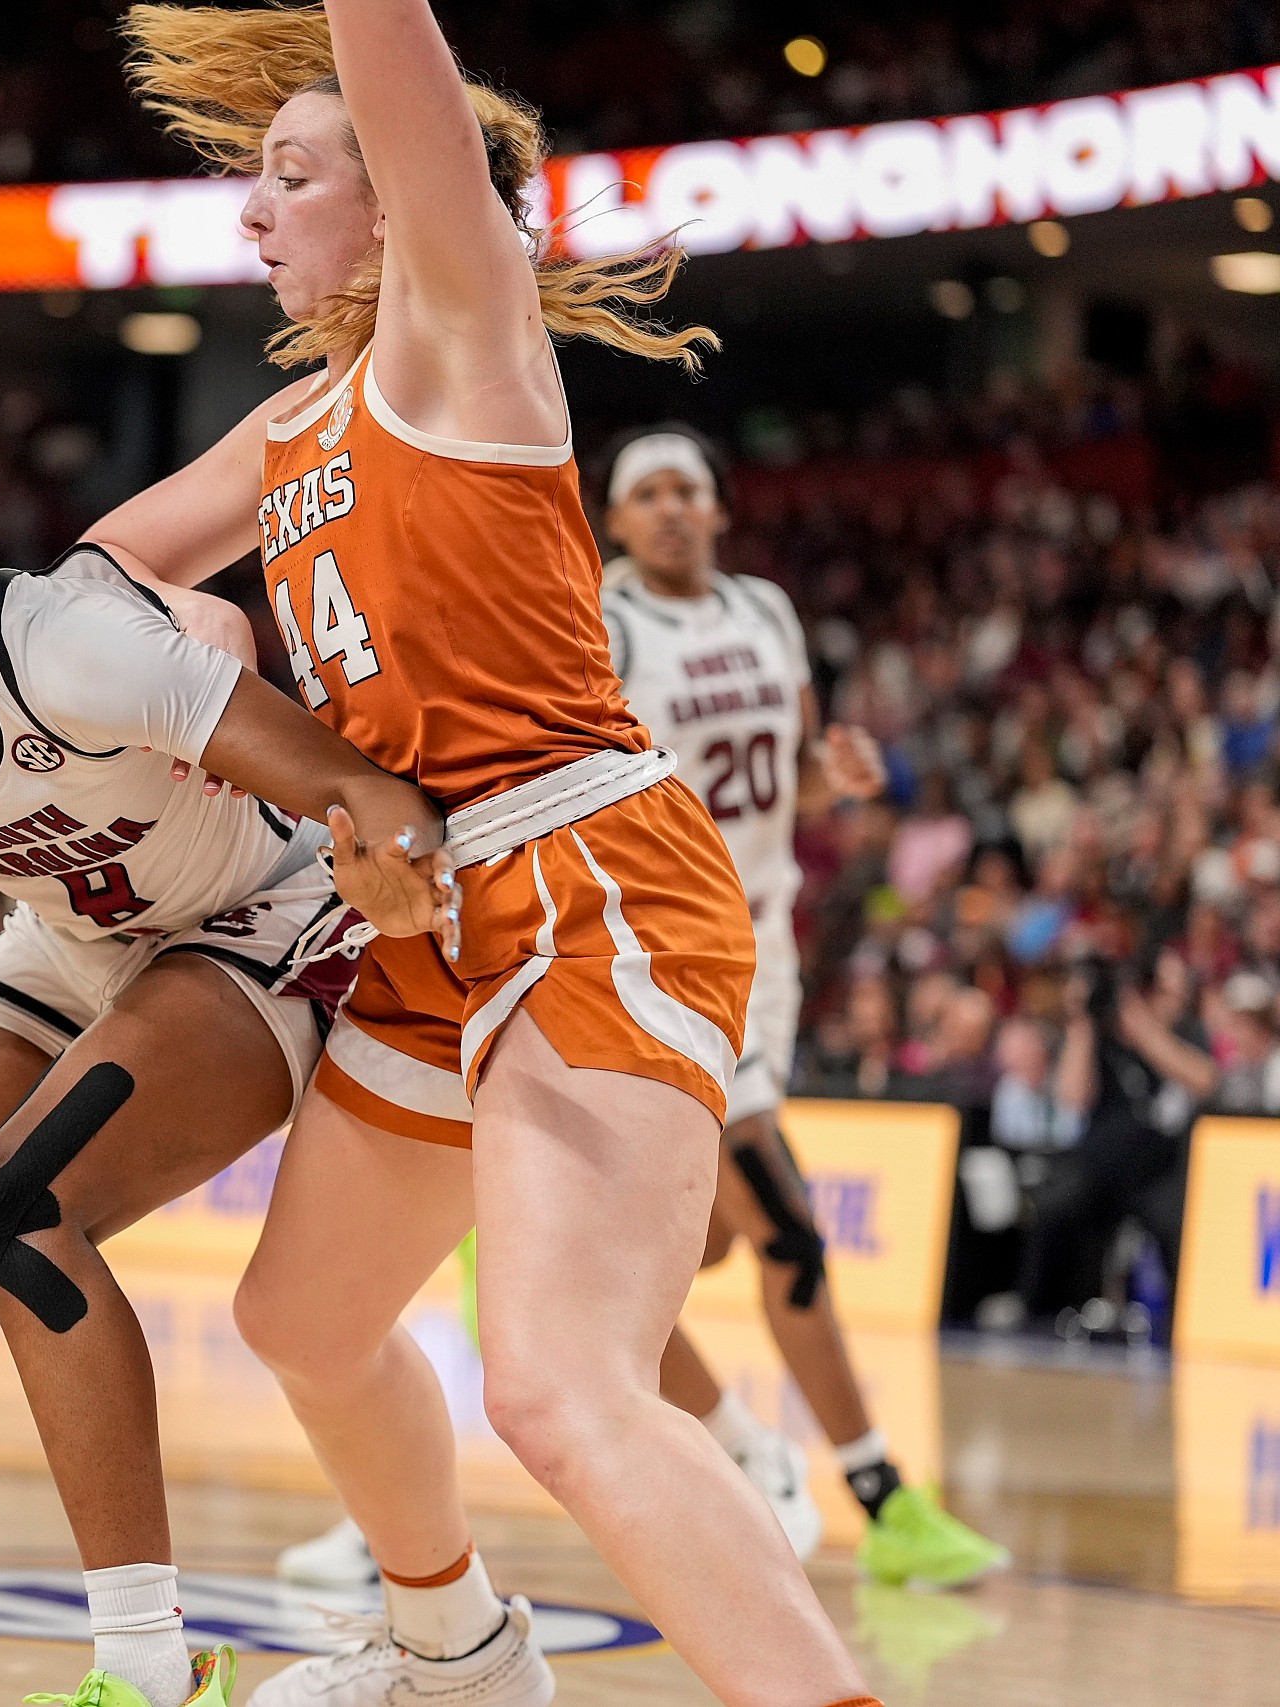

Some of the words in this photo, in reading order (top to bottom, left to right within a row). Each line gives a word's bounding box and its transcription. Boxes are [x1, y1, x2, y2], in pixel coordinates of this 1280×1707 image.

[258, 449, 356, 567] EXAS
[275, 549, 381, 710] 44
[15, 737, 62, 771] SEC
[704, 731, 779, 821] 20
